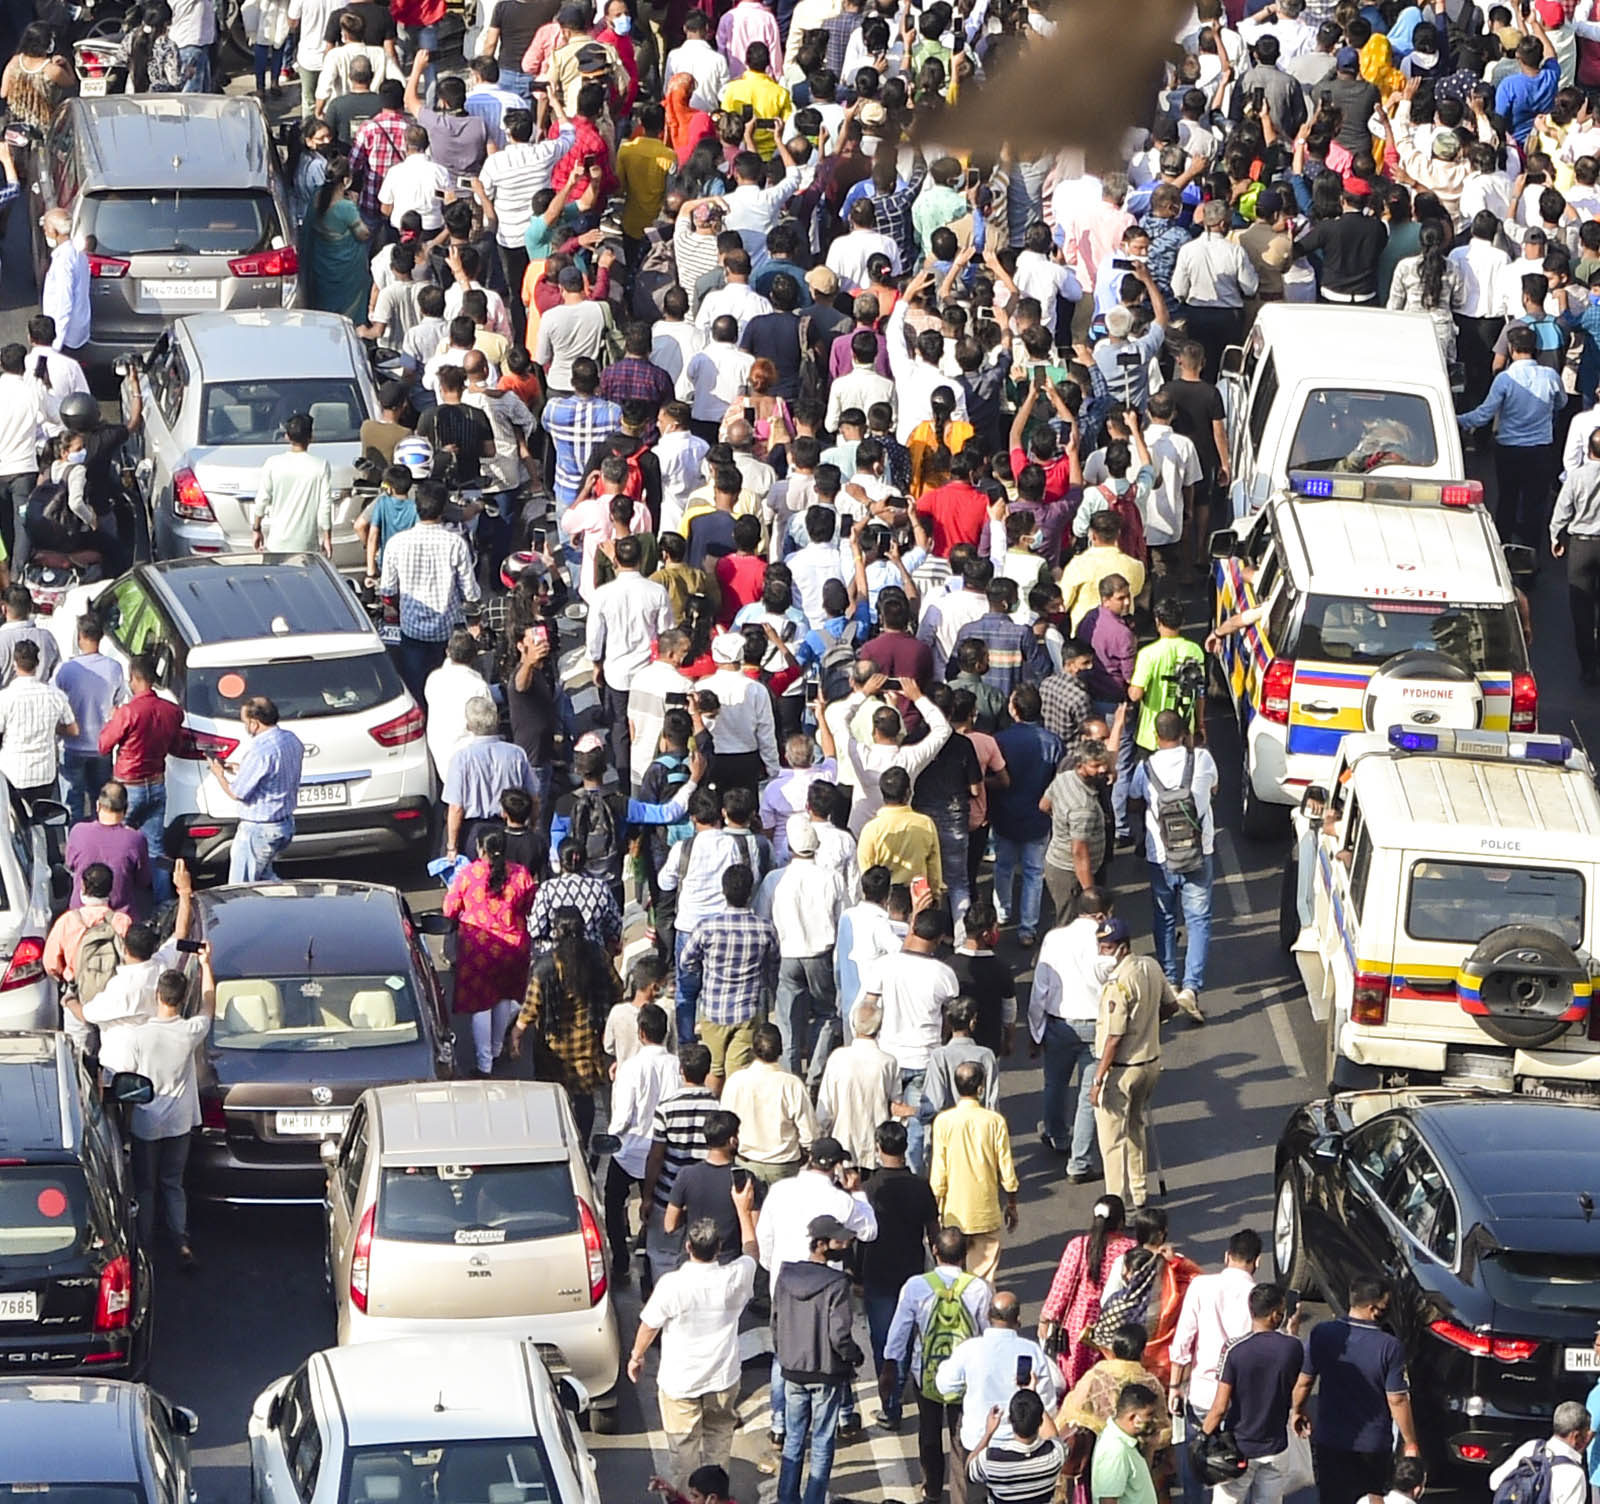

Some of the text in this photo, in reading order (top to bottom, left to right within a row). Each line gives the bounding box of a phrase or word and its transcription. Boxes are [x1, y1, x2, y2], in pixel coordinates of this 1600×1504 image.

[1402, 688, 1454, 699] PYDHONIE
[1480, 840, 1522, 851] POLICE
[282, 1117, 295, 1127] MH
[467, 1270, 492, 1278] TATA
[1, 1300, 33, 1315] 7685
[1575, 1352, 1591, 1367] MH
